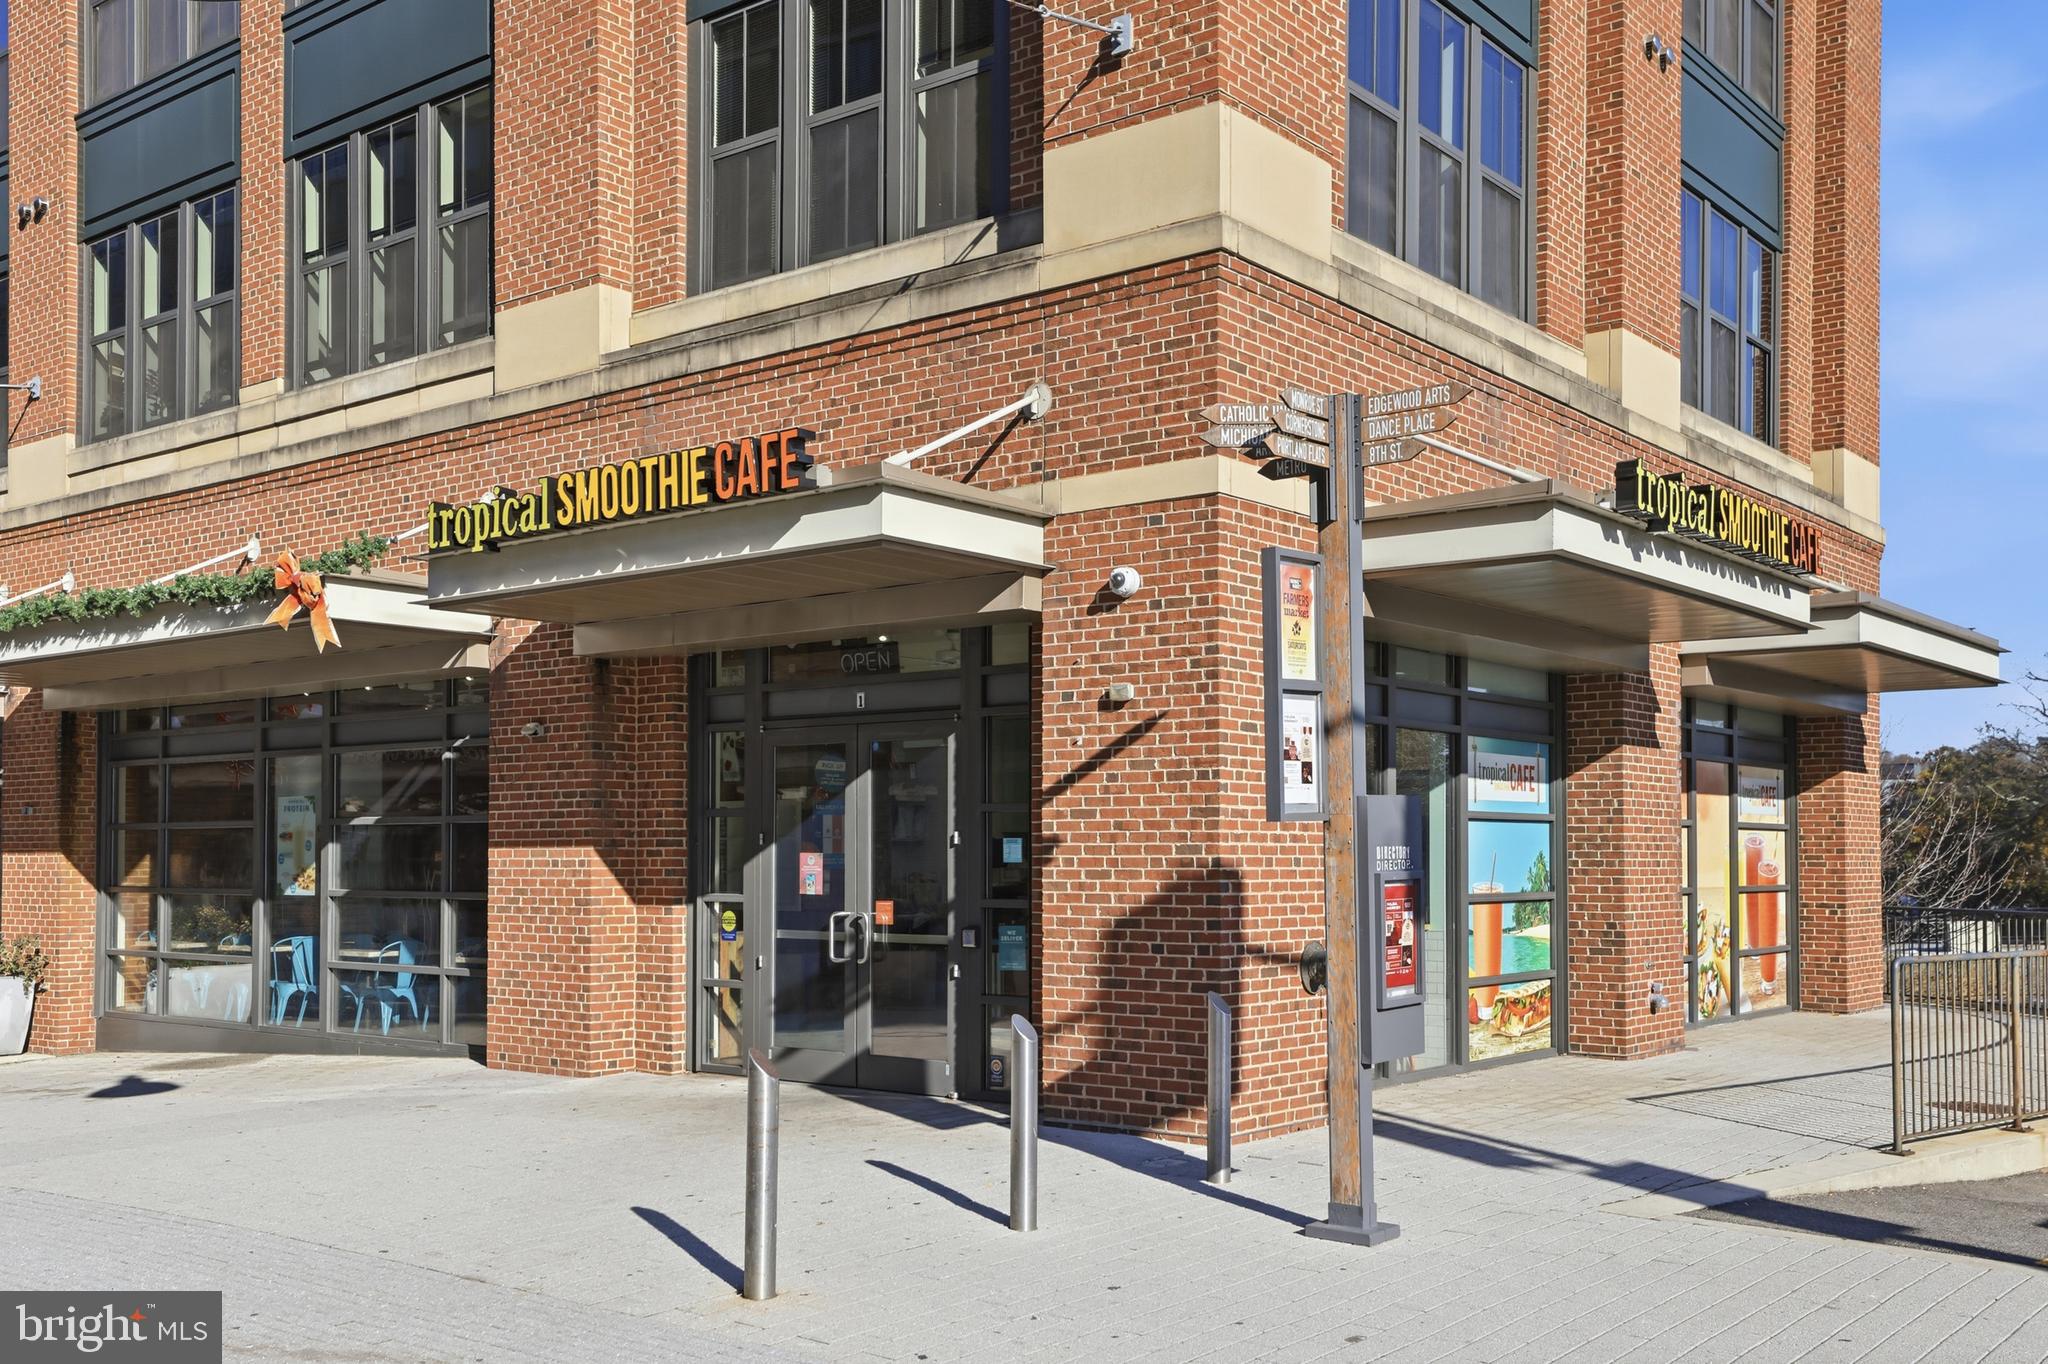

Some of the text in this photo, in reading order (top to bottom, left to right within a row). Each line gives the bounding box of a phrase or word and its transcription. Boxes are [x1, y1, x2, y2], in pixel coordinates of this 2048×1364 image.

[1368, 385, 1450, 414] EDGEWOOD ARTS
[1220, 405, 1269, 422] CATHOLIC
[1369, 412, 1435, 438] DANCE PLACE
[1277, 435, 1307, 460] PORTLAND
[1369, 442, 1403, 463] 8TH ST.
[428, 428, 800, 552] tropical SMOOTHIE CAFE
[1636, 457, 1823, 576] tropical SMOOTHIE CAFE
[841, 651, 890, 672] OPEN
[1478, 763, 1535, 792] tropical CAFE
[1376, 846, 1410, 859] DIRECTORY
